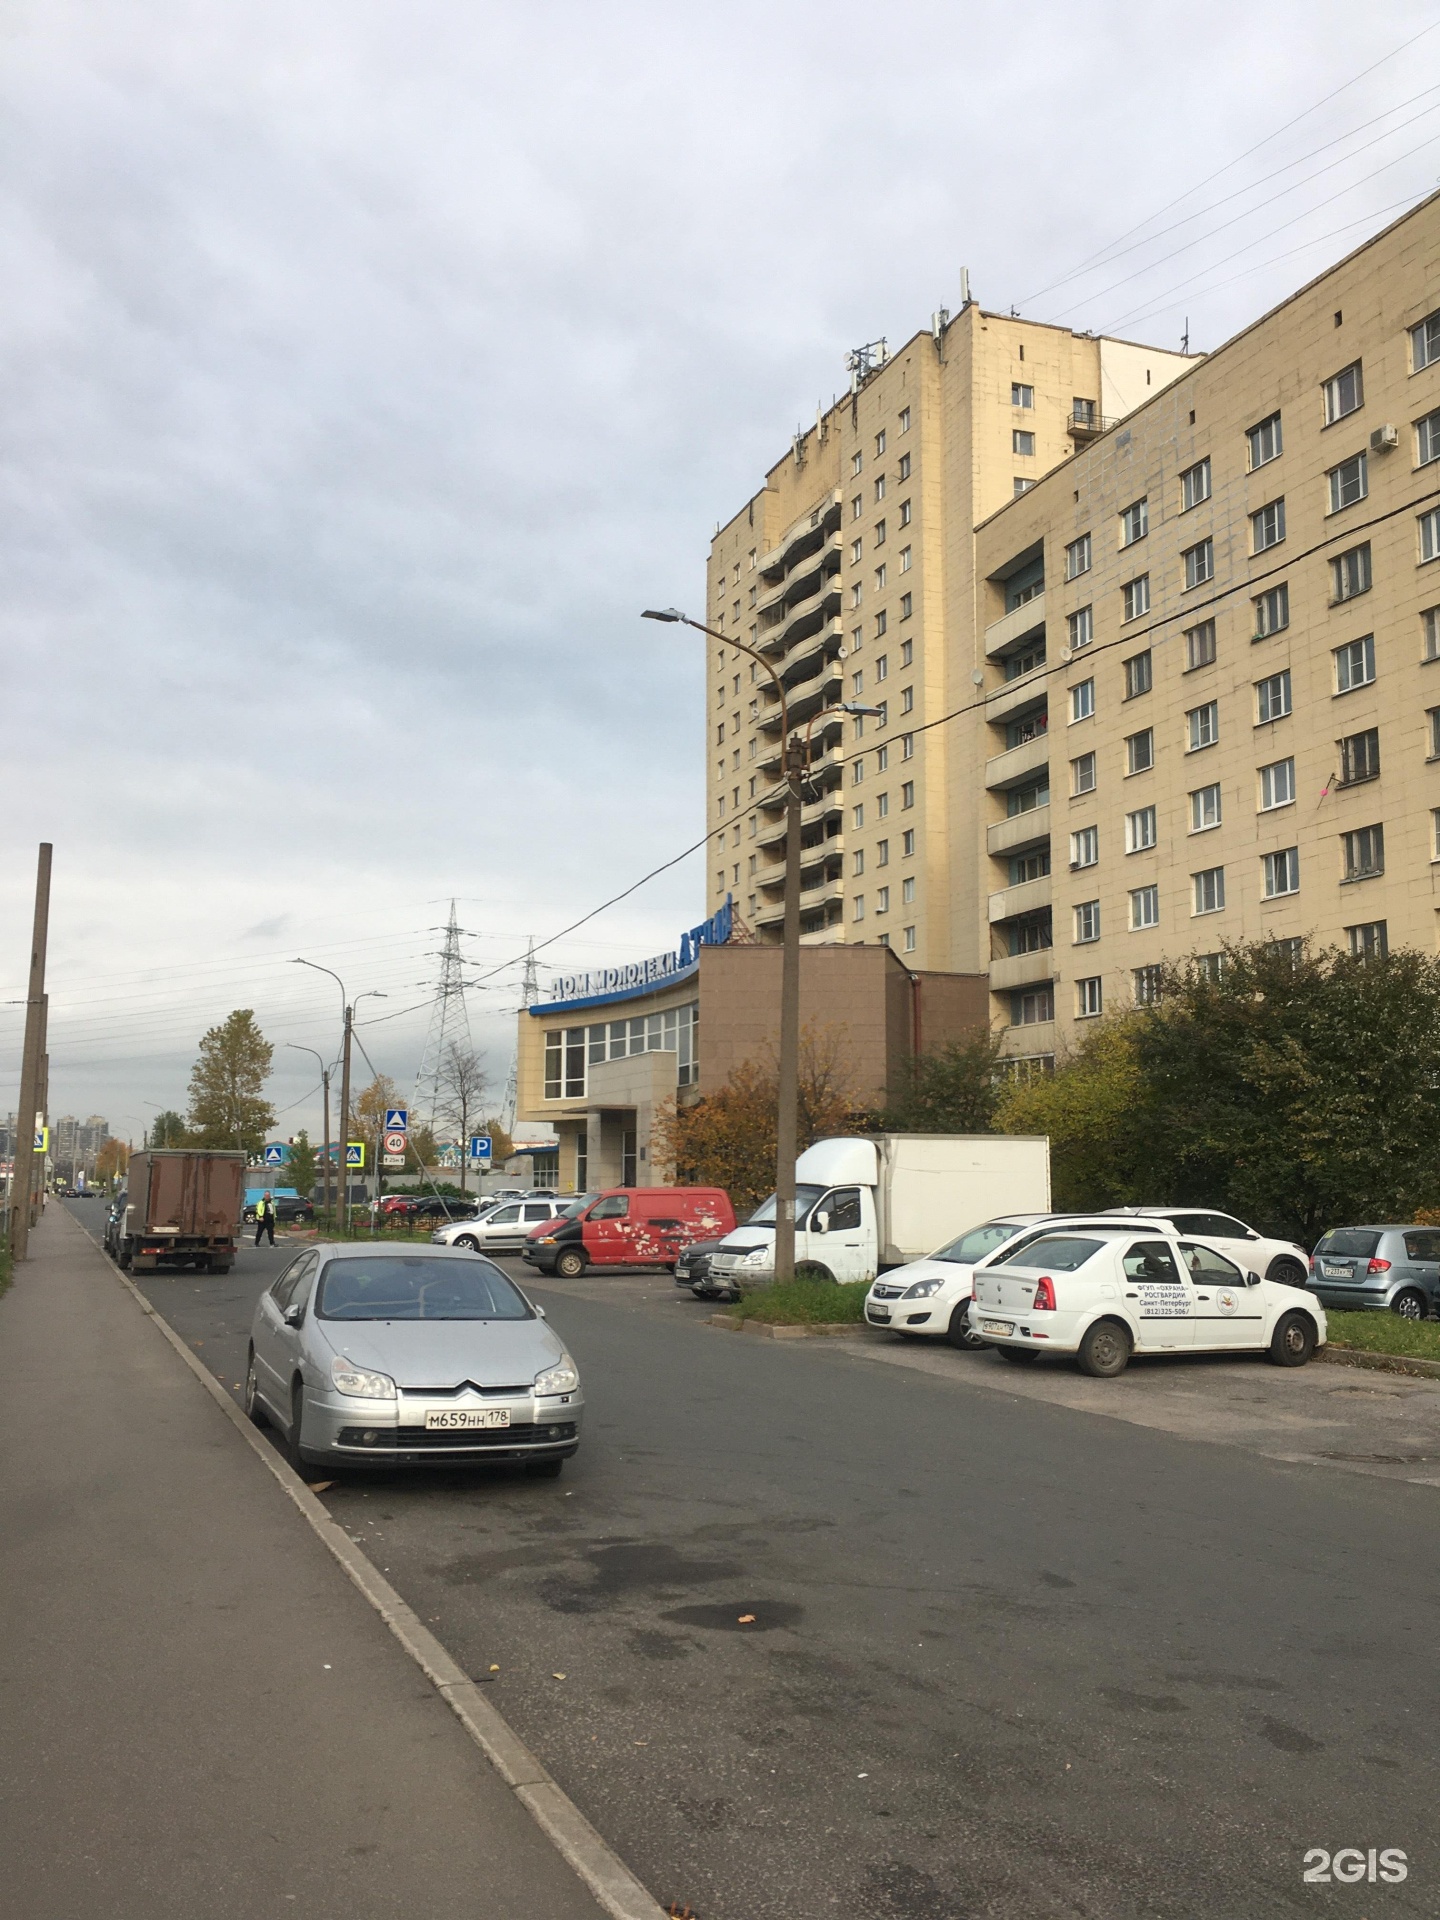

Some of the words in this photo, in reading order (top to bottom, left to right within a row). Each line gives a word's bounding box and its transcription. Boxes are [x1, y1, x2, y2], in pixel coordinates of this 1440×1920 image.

[550, 973, 589, 1001] ДОМ
[594, 951, 677, 990] МОЛОДЕЖИ
[389, 1138, 402, 1147] 40
[476, 1139, 488, 1156] P
[430, 1412, 485, 1427] М659НН
[488, 1410, 507, 1422] 178
